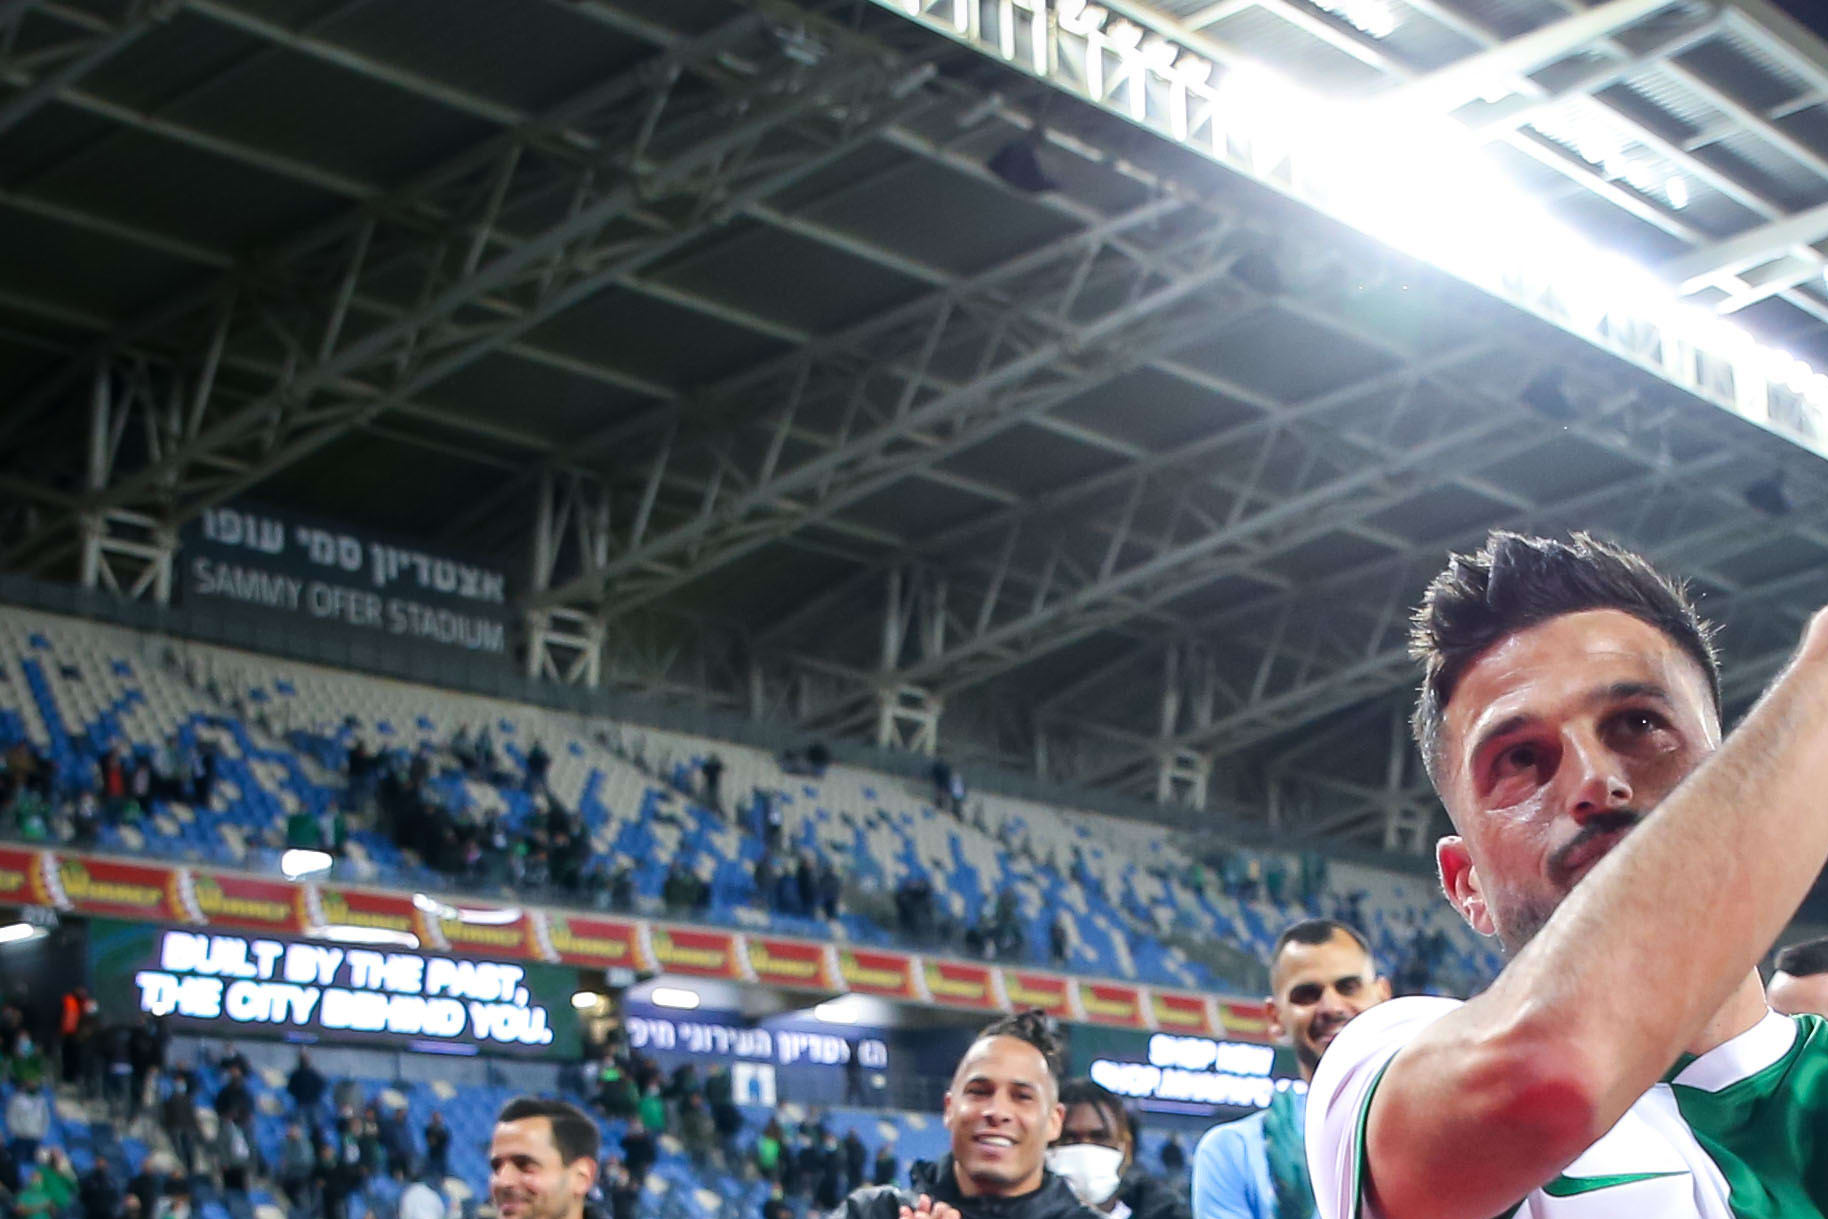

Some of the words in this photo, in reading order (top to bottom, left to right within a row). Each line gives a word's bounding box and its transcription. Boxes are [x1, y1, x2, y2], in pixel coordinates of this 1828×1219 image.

[191, 555, 302, 610] SAMMY
[306, 580, 384, 629] OFER
[387, 597, 505, 652] STADIUM
[160, 931, 284, 979] BUILT
[284, 943, 343, 985] BY
[346, 950, 426, 994] THE
[425, 957, 530, 1007] PAST,
[136, 970, 224, 1018] THE
[226, 980, 321, 1024] CITY
[319, 987, 467, 1037] BEHIND
[469, 1001, 554, 1045] YOU.
